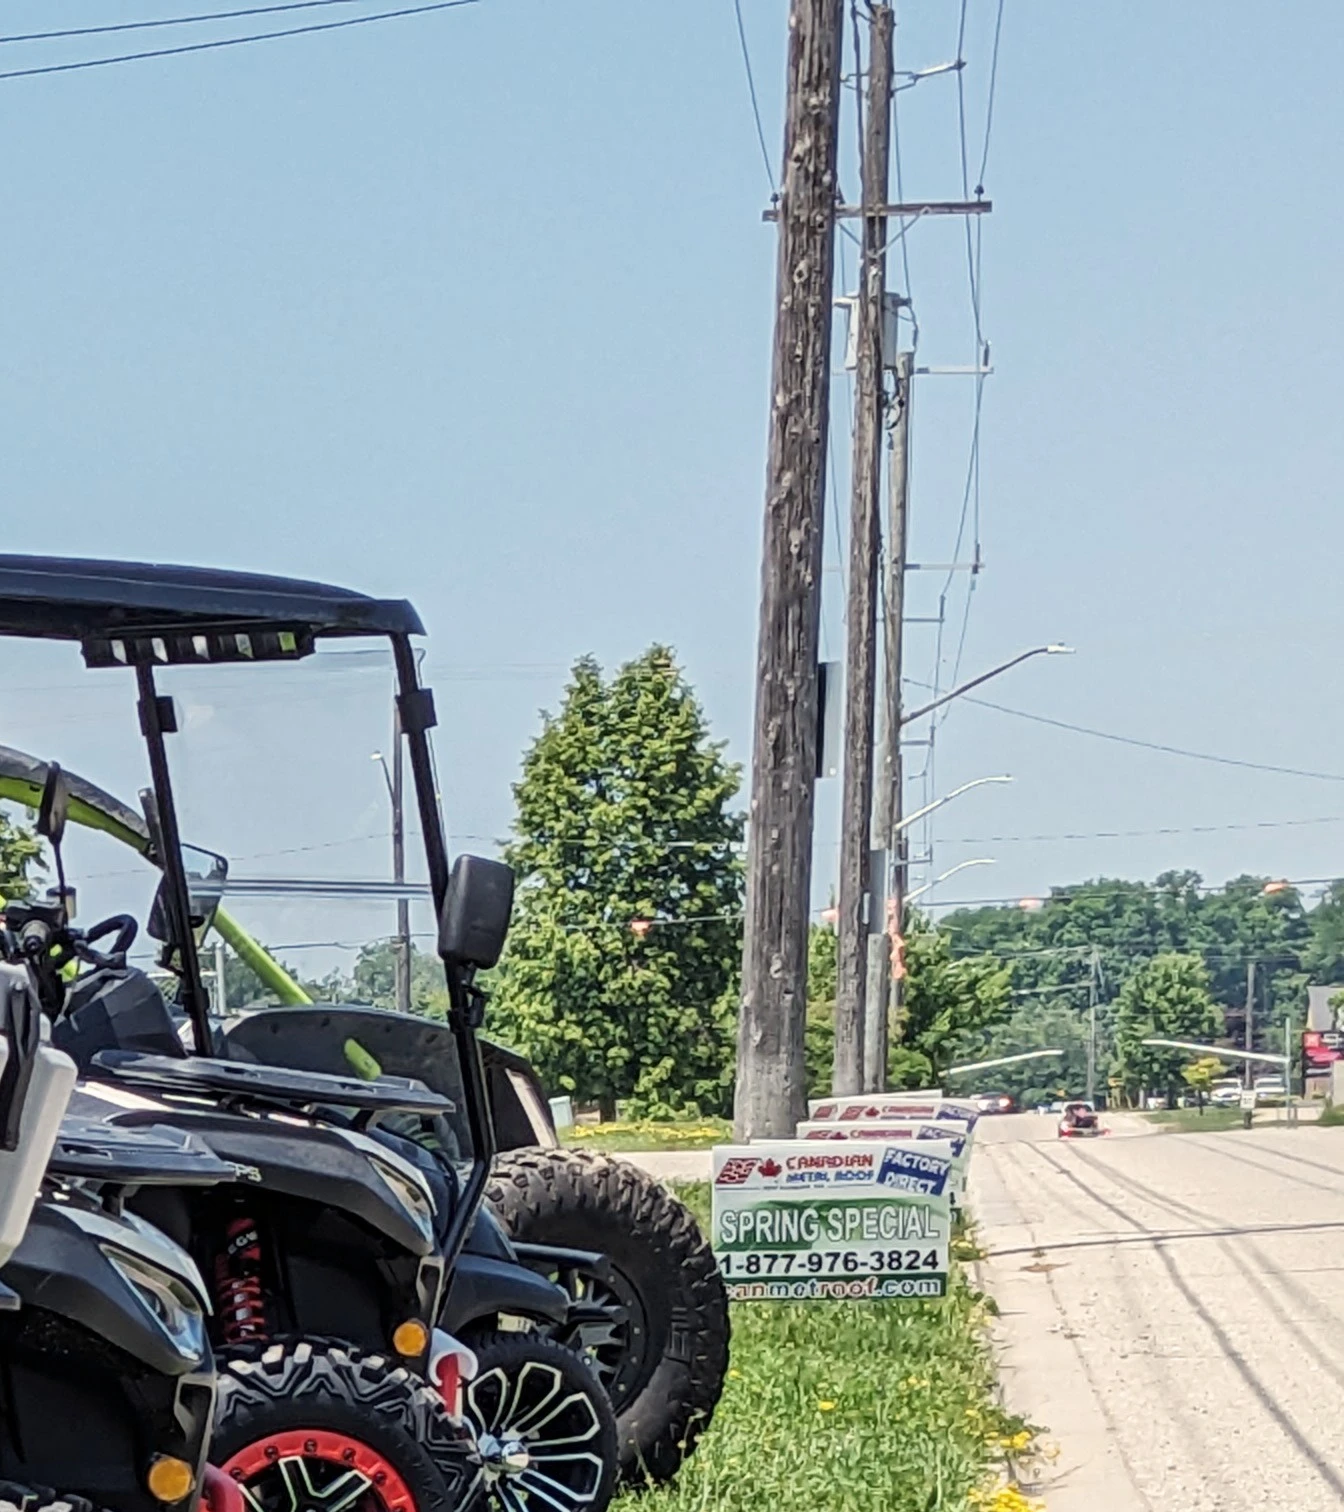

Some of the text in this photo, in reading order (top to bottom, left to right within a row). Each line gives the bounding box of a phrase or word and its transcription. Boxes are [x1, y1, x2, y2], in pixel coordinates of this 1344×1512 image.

[786, 1154, 874, 1170] CANADIAN
[884, 1149, 952, 1176] FACTORY
[884, 1171, 937, 1195] DIRECT
[720, 1204, 940, 1244] SPRING SPECIAL
[719, 1249, 939, 1275] 1-877-976-3824
